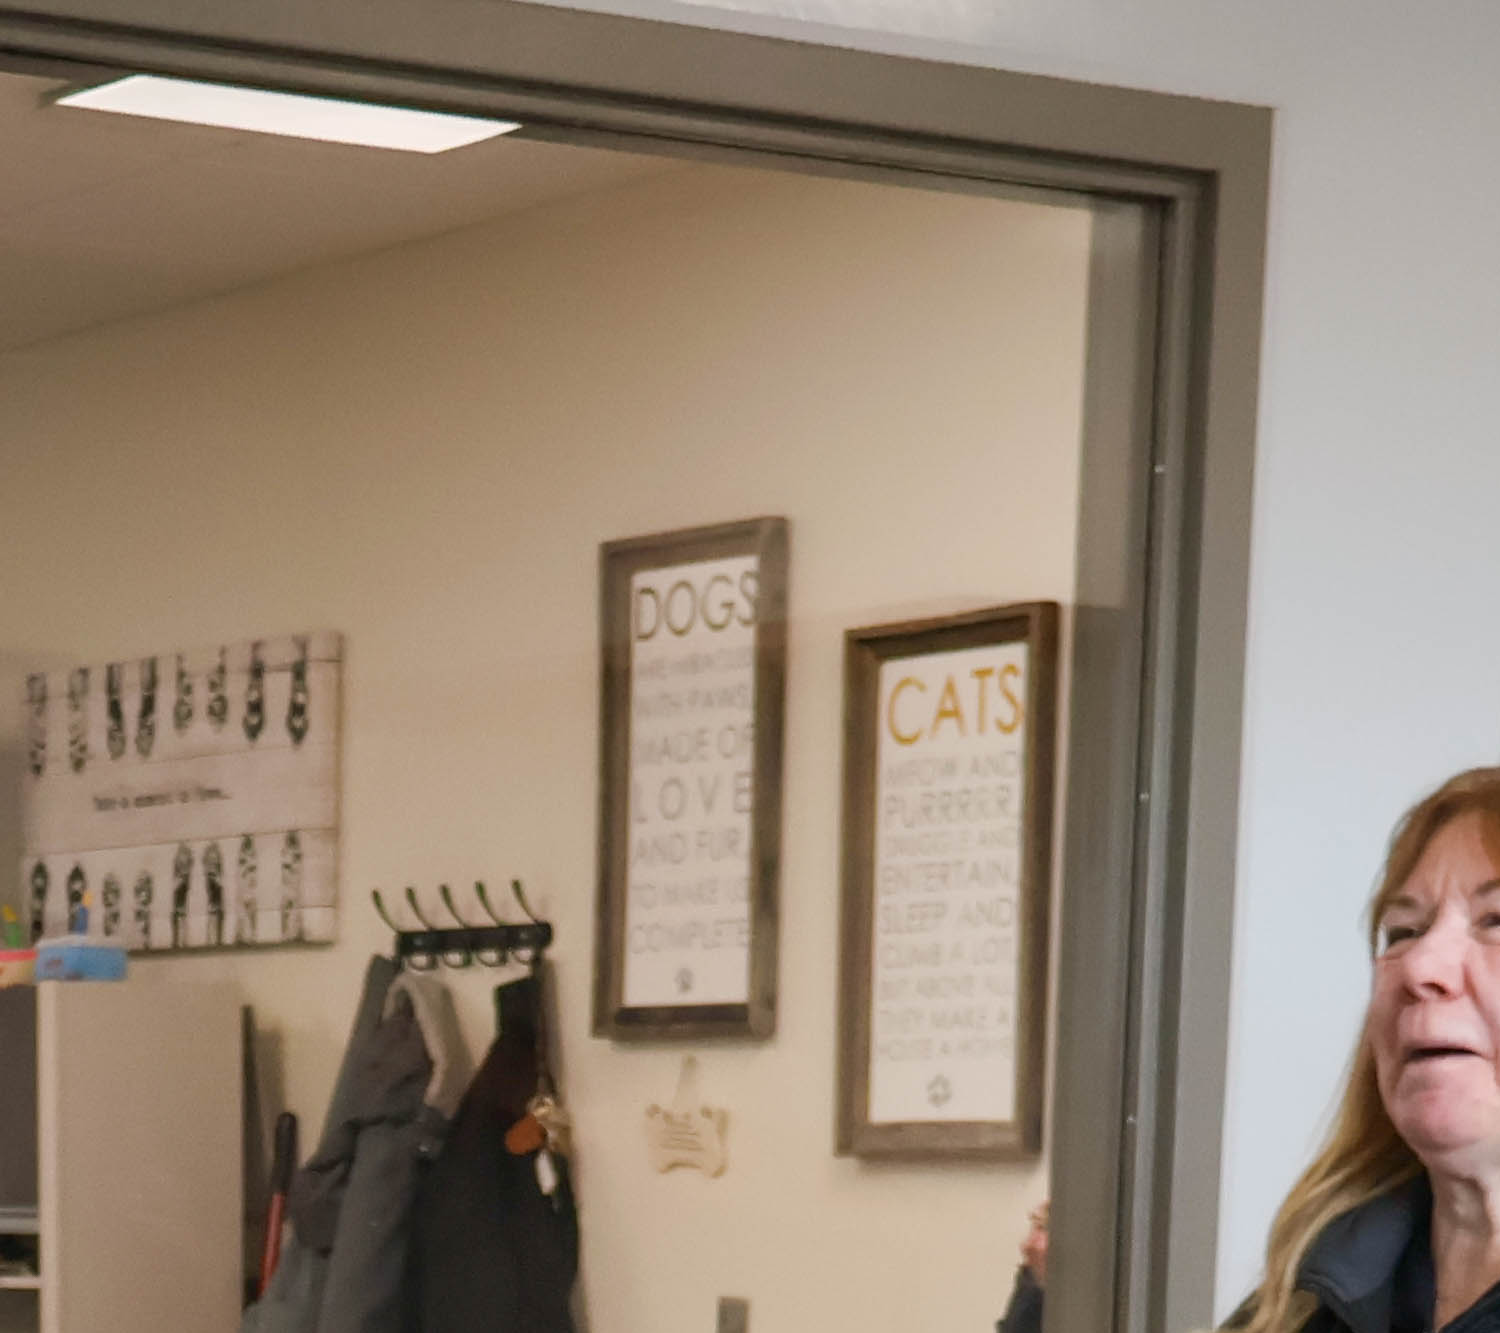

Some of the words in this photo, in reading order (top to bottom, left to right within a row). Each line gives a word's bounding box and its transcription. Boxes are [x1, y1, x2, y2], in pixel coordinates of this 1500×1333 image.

[634, 572, 758, 641] DOGS
[888, 663, 1024, 746] CATS
[637, 727, 709, 766] MADE
[631, 771, 754, 824] LOVE
[632, 831, 687, 867] AND
[957, 897, 1013, 930] AND
